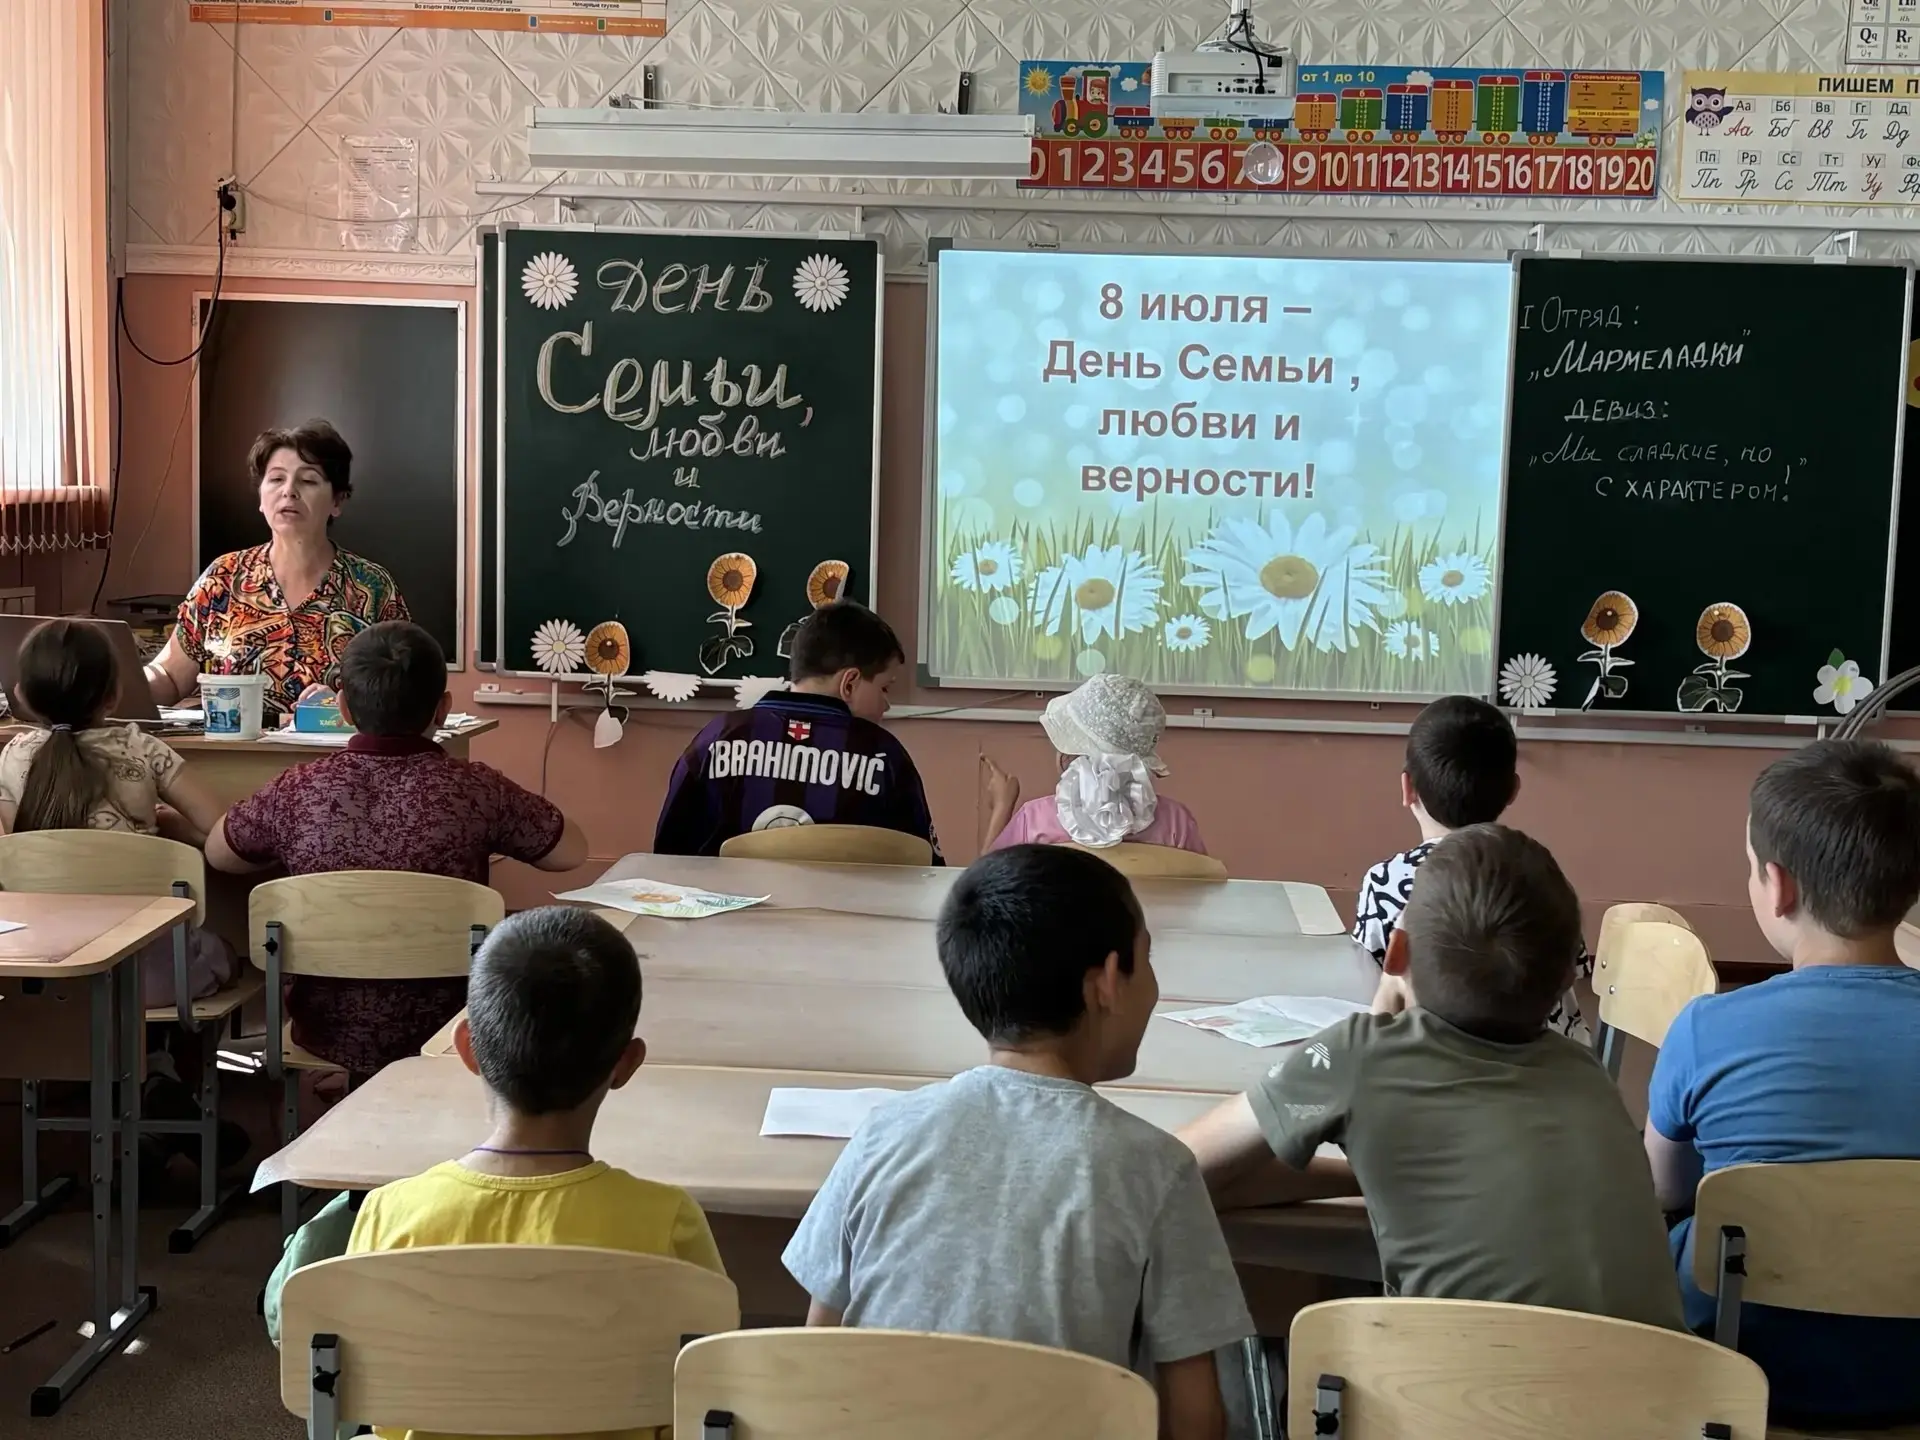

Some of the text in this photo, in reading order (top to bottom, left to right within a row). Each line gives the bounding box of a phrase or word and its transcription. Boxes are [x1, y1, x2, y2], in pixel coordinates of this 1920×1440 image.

[1860, 28, 1912, 44] Qq Rr
[1302, 71, 1375, 84] от 1 до 10
[1497, 76, 1502, 84] 9
[1818, 77, 1919, 93] ПИШЕМ П
[1735, 100, 1908, 114] Аа Бб Вв Гг Дд
[1724, 117, 1910, 148] Аа Бб Вв Гг Дд
[1057, 148, 1071, 181] 1
[1083, 148, 1105, 182] 2
[1112, 148, 1135, 182] 3
[1141, 149, 1166, 183] 4
[1173, 149, 1194, 183] 5
[1201, 149, 1225, 184] 6
[1293, 152, 1316, 186] 9
[1320, 152, 1348, 187] 10
[1352, 152, 1378, 187] 11
[1382, 153, 1409, 188] 12
[1413, 153, 1439, 188] 13
[1443, 154, 1470, 188] 14
[1474, 155, 1500, 189] 15
[1504, 155, 1531, 189] 16
[1535, 155, 1563, 189] 17
[1566, 156, 1592, 190] 18
[1596, 156, 1623, 191] 19
[1625, 157, 1654, 191] 20
[1699, 151, 1716, 163] Пп
[1742, 153, 1757, 165] Рр
[1782, 154, 1797, 164] Сс
[1825, 154, 1839, 165] Тт
[1866, 155, 1881, 168] Уу
[1691, 168, 1722, 189] Пп
[1735, 169, 1759, 197] Рр
[1775, 170, 1794, 191] Сс
[1807, 171, 1847, 191] Тт
[1861, 172, 1883, 200] Уу
[1099, 283, 1124, 320] 8
[1140, 293, 1268, 324] июля
[536, 319, 813, 430] Семьи,
[1042, 339, 1162, 384] День
[1178, 343, 1333, 384] Семьи
[629, 410, 788, 462] любви
[1098, 401, 1300, 441] любви и
[672, 466, 701, 489] и
[1081, 463, 1315, 503] верности!
[708, 739, 888, 796] IBRAHIMOVIĆ
